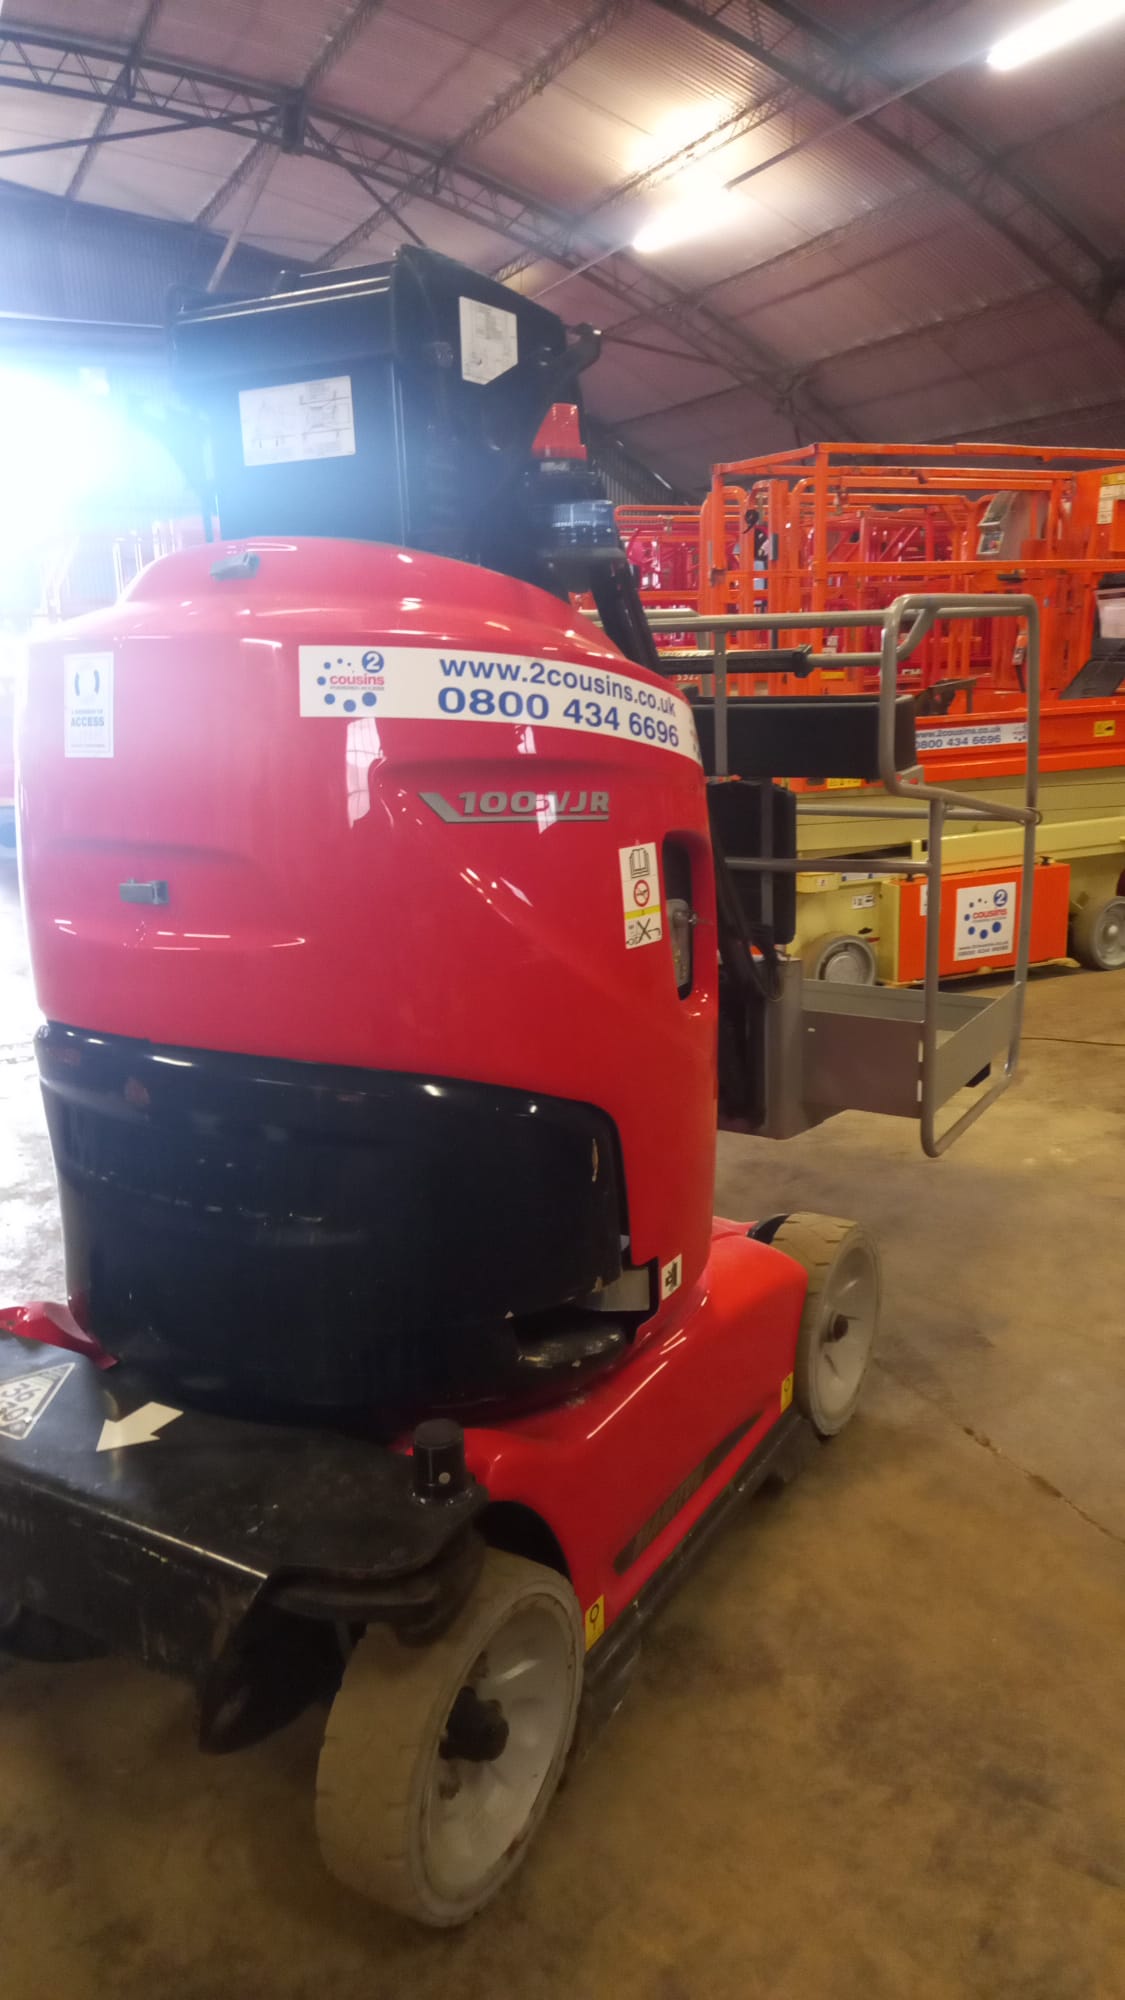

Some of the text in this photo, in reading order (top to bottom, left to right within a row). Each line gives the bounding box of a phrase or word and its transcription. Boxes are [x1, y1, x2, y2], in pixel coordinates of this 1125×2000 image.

[364, 652, 383, 672] 2
[330, 672, 384, 685] cousins
[440, 658, 675, 717] www.2cousins.co.uk
[71, 716, 105, 727] ACCESS
[438, 686, 680, 747] 0800 434 6696
[947, 737, 968, 746] 434
[995, 890, 1006, 906] 2
